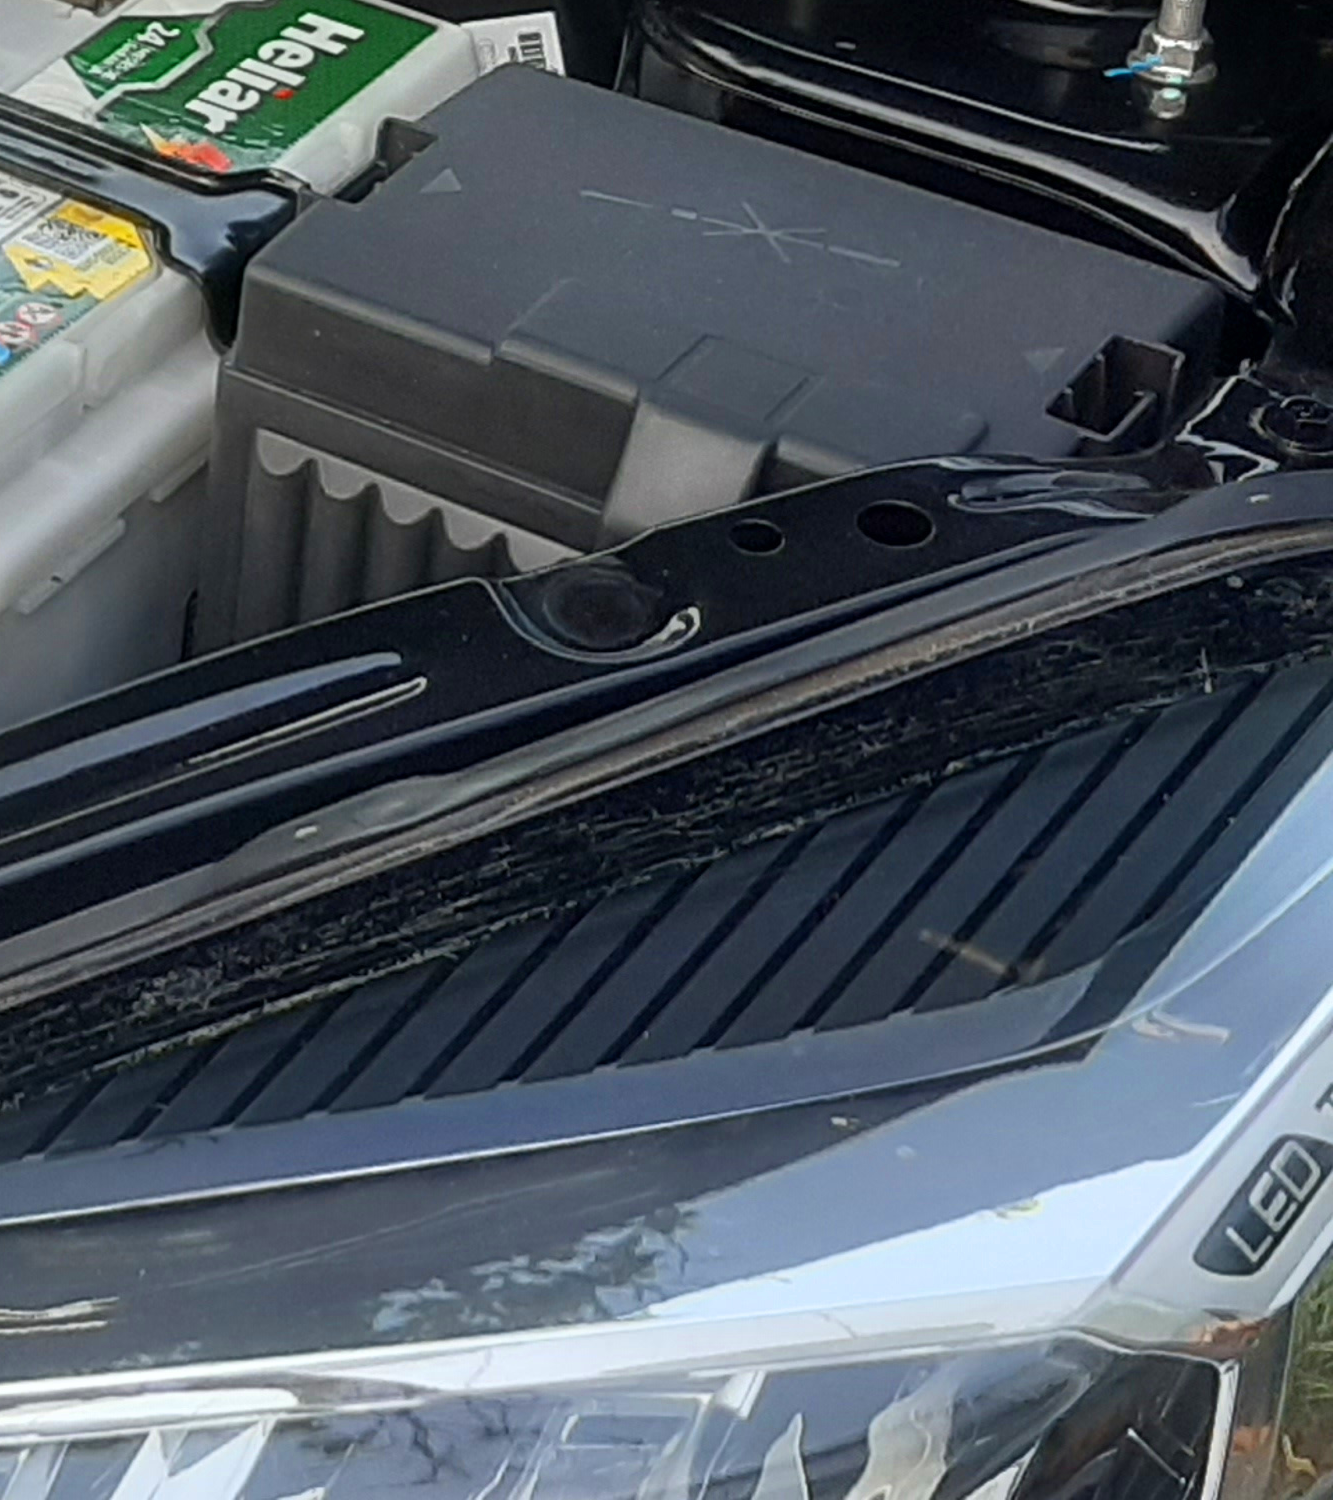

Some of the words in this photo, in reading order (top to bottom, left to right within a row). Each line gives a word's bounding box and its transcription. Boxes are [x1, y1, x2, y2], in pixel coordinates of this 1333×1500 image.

[136, 21, 181, 47] 24
[185, 12, 365, 134] Heliar
[1225, 1140, 1321, 1264] LED
